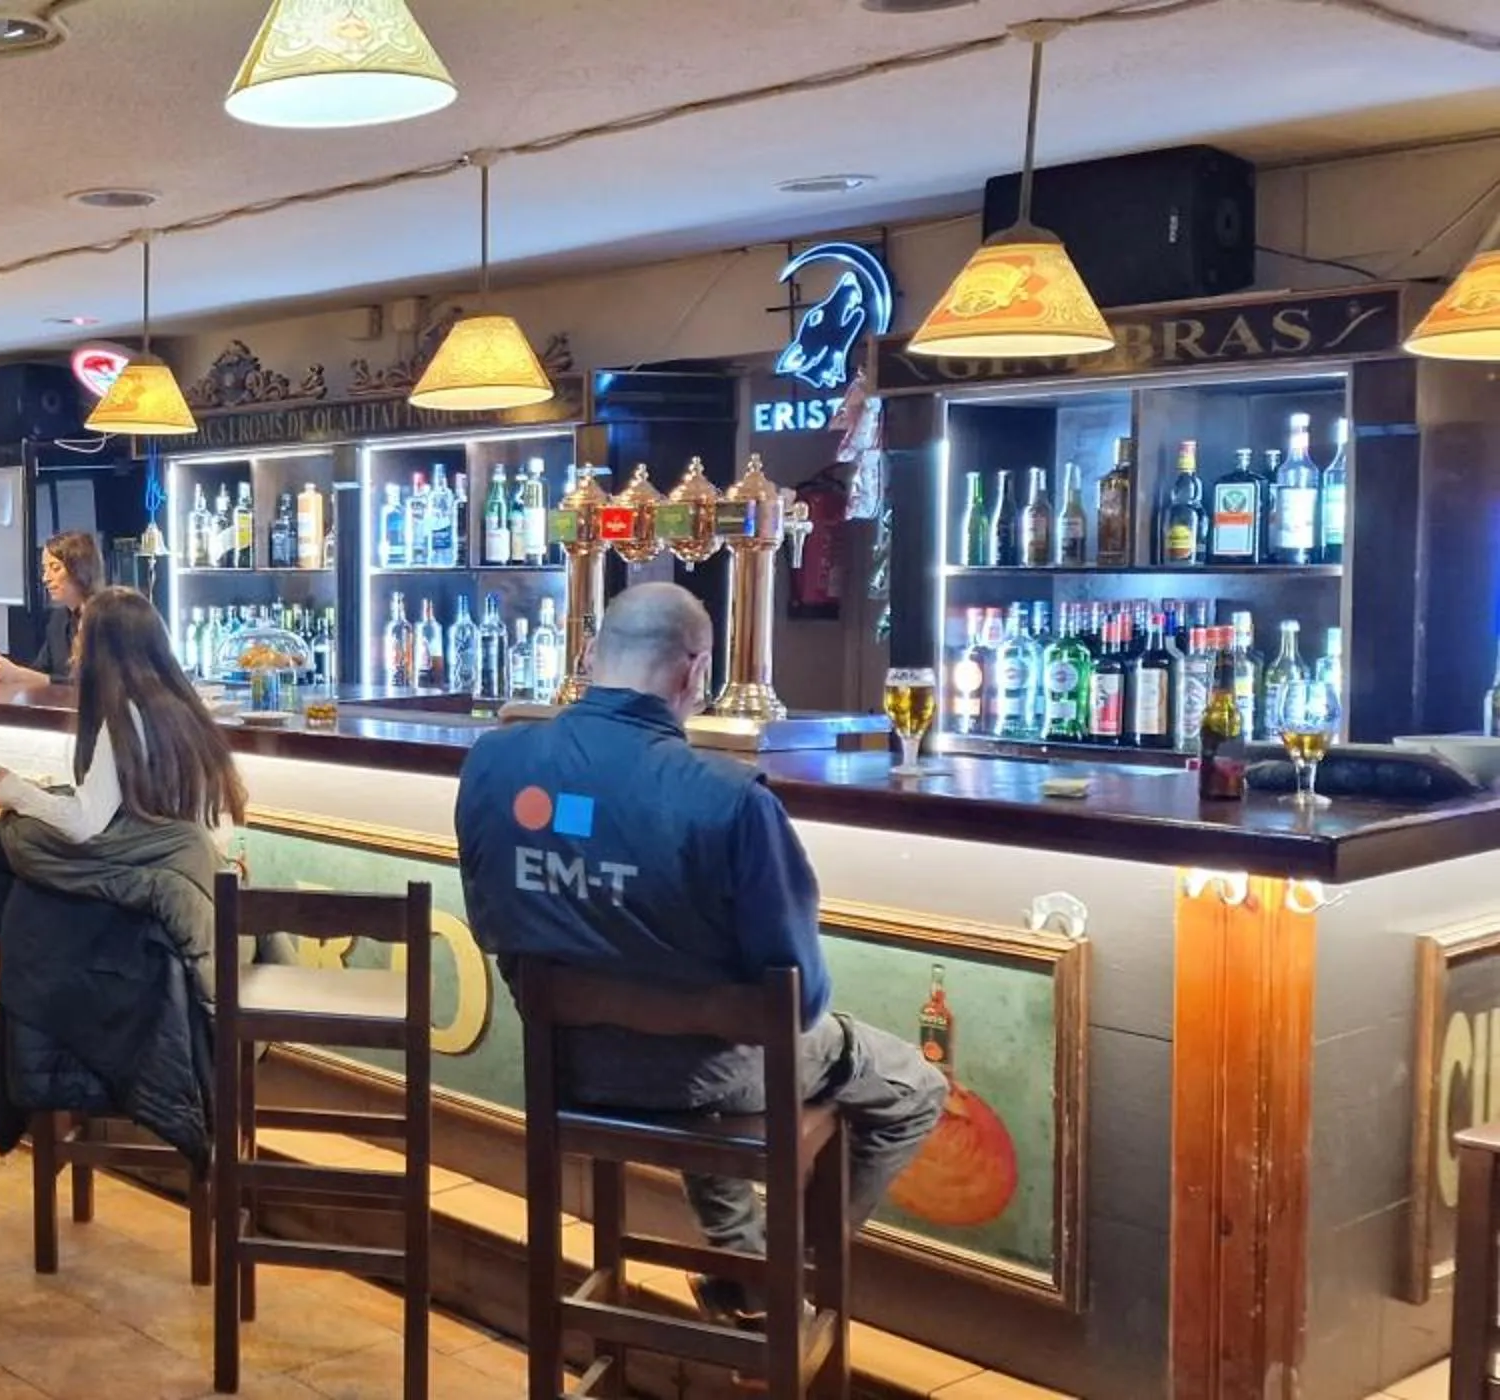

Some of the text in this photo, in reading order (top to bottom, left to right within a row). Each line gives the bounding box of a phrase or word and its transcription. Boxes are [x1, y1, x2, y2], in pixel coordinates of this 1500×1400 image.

[936, 309, 1312, 379] GBRAS
[754, 396, 848, 432] ERIST
[515, 846, 639, 907] EM-T
